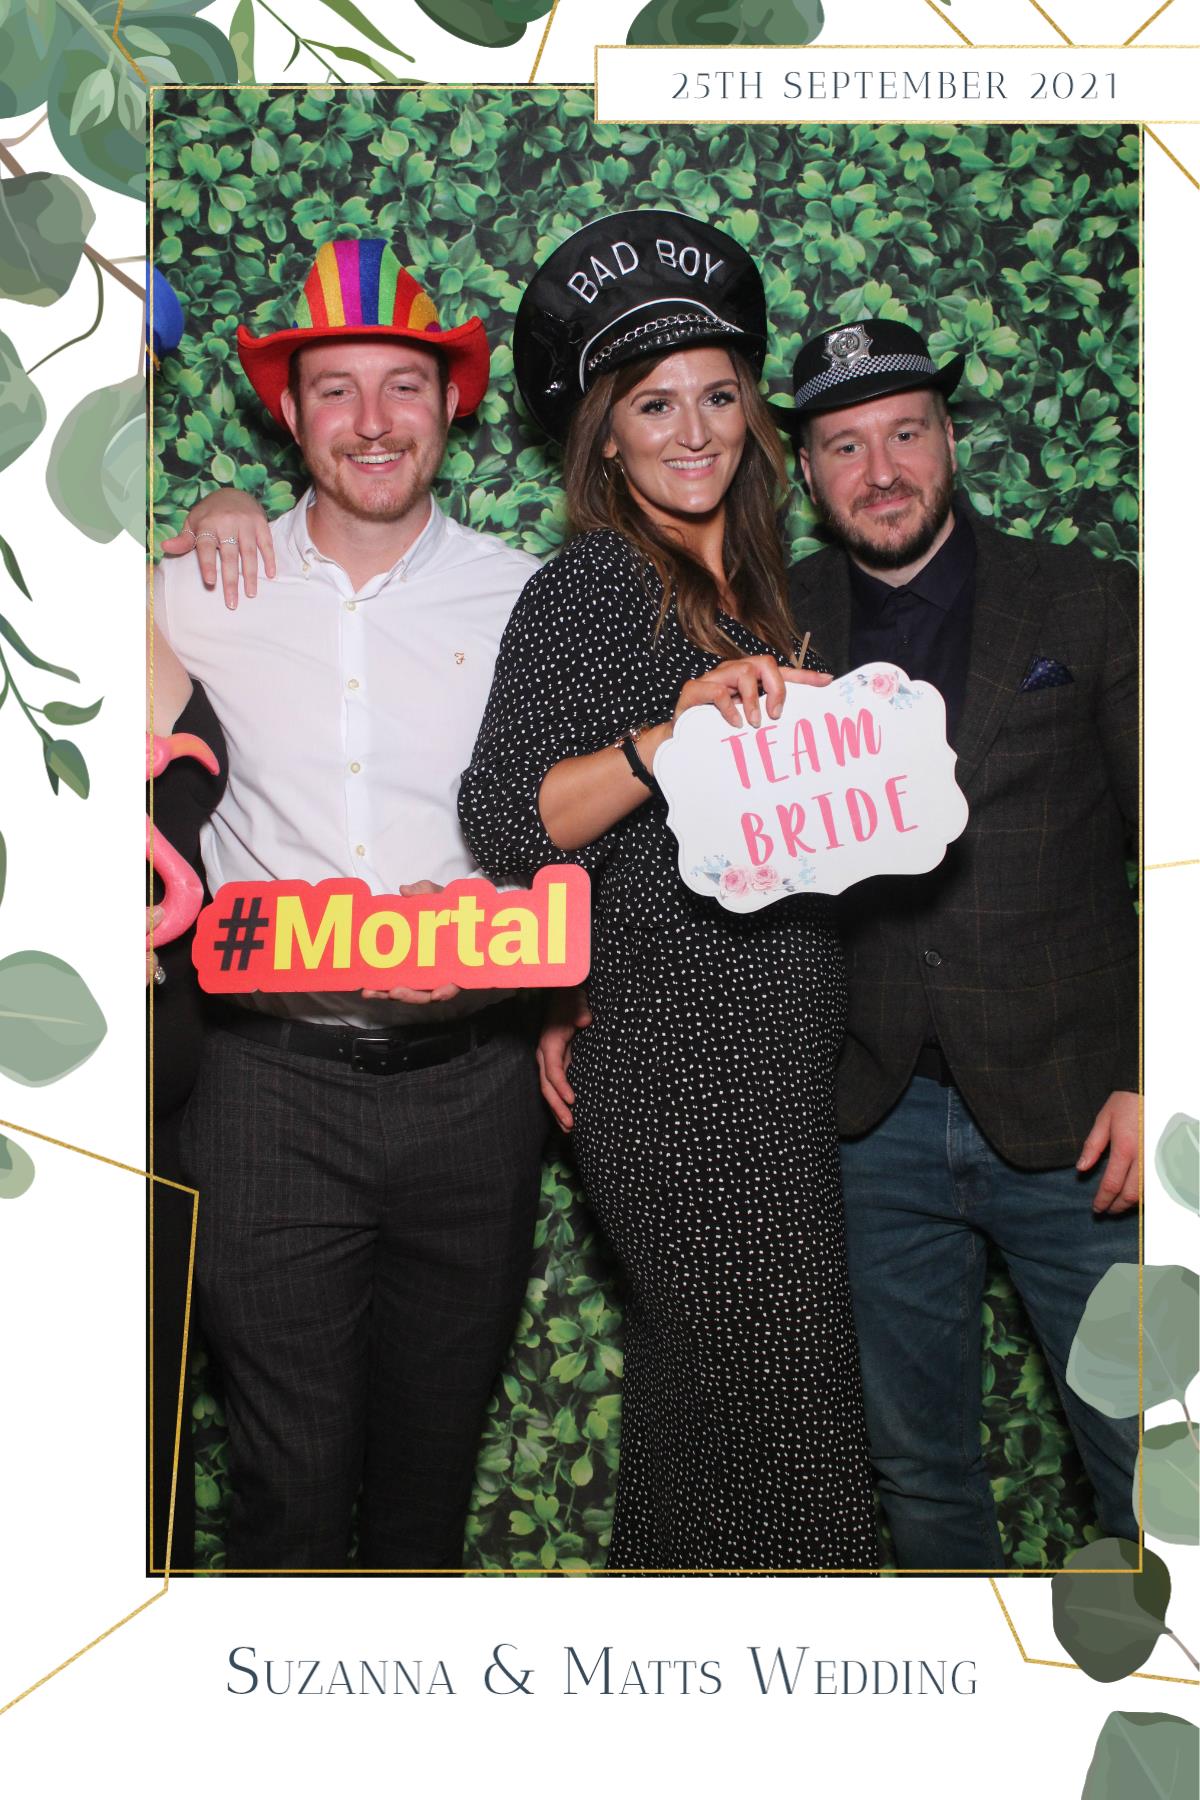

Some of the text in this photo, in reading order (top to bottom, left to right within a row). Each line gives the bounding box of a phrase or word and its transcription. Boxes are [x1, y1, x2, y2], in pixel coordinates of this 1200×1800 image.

[567, 239, 725, 303] BAD BOY
[721, 708, 882, 789] TEAM
[740, 775, 919, 866] BRIDE
[213, 883, 567, 972] #Mortal
